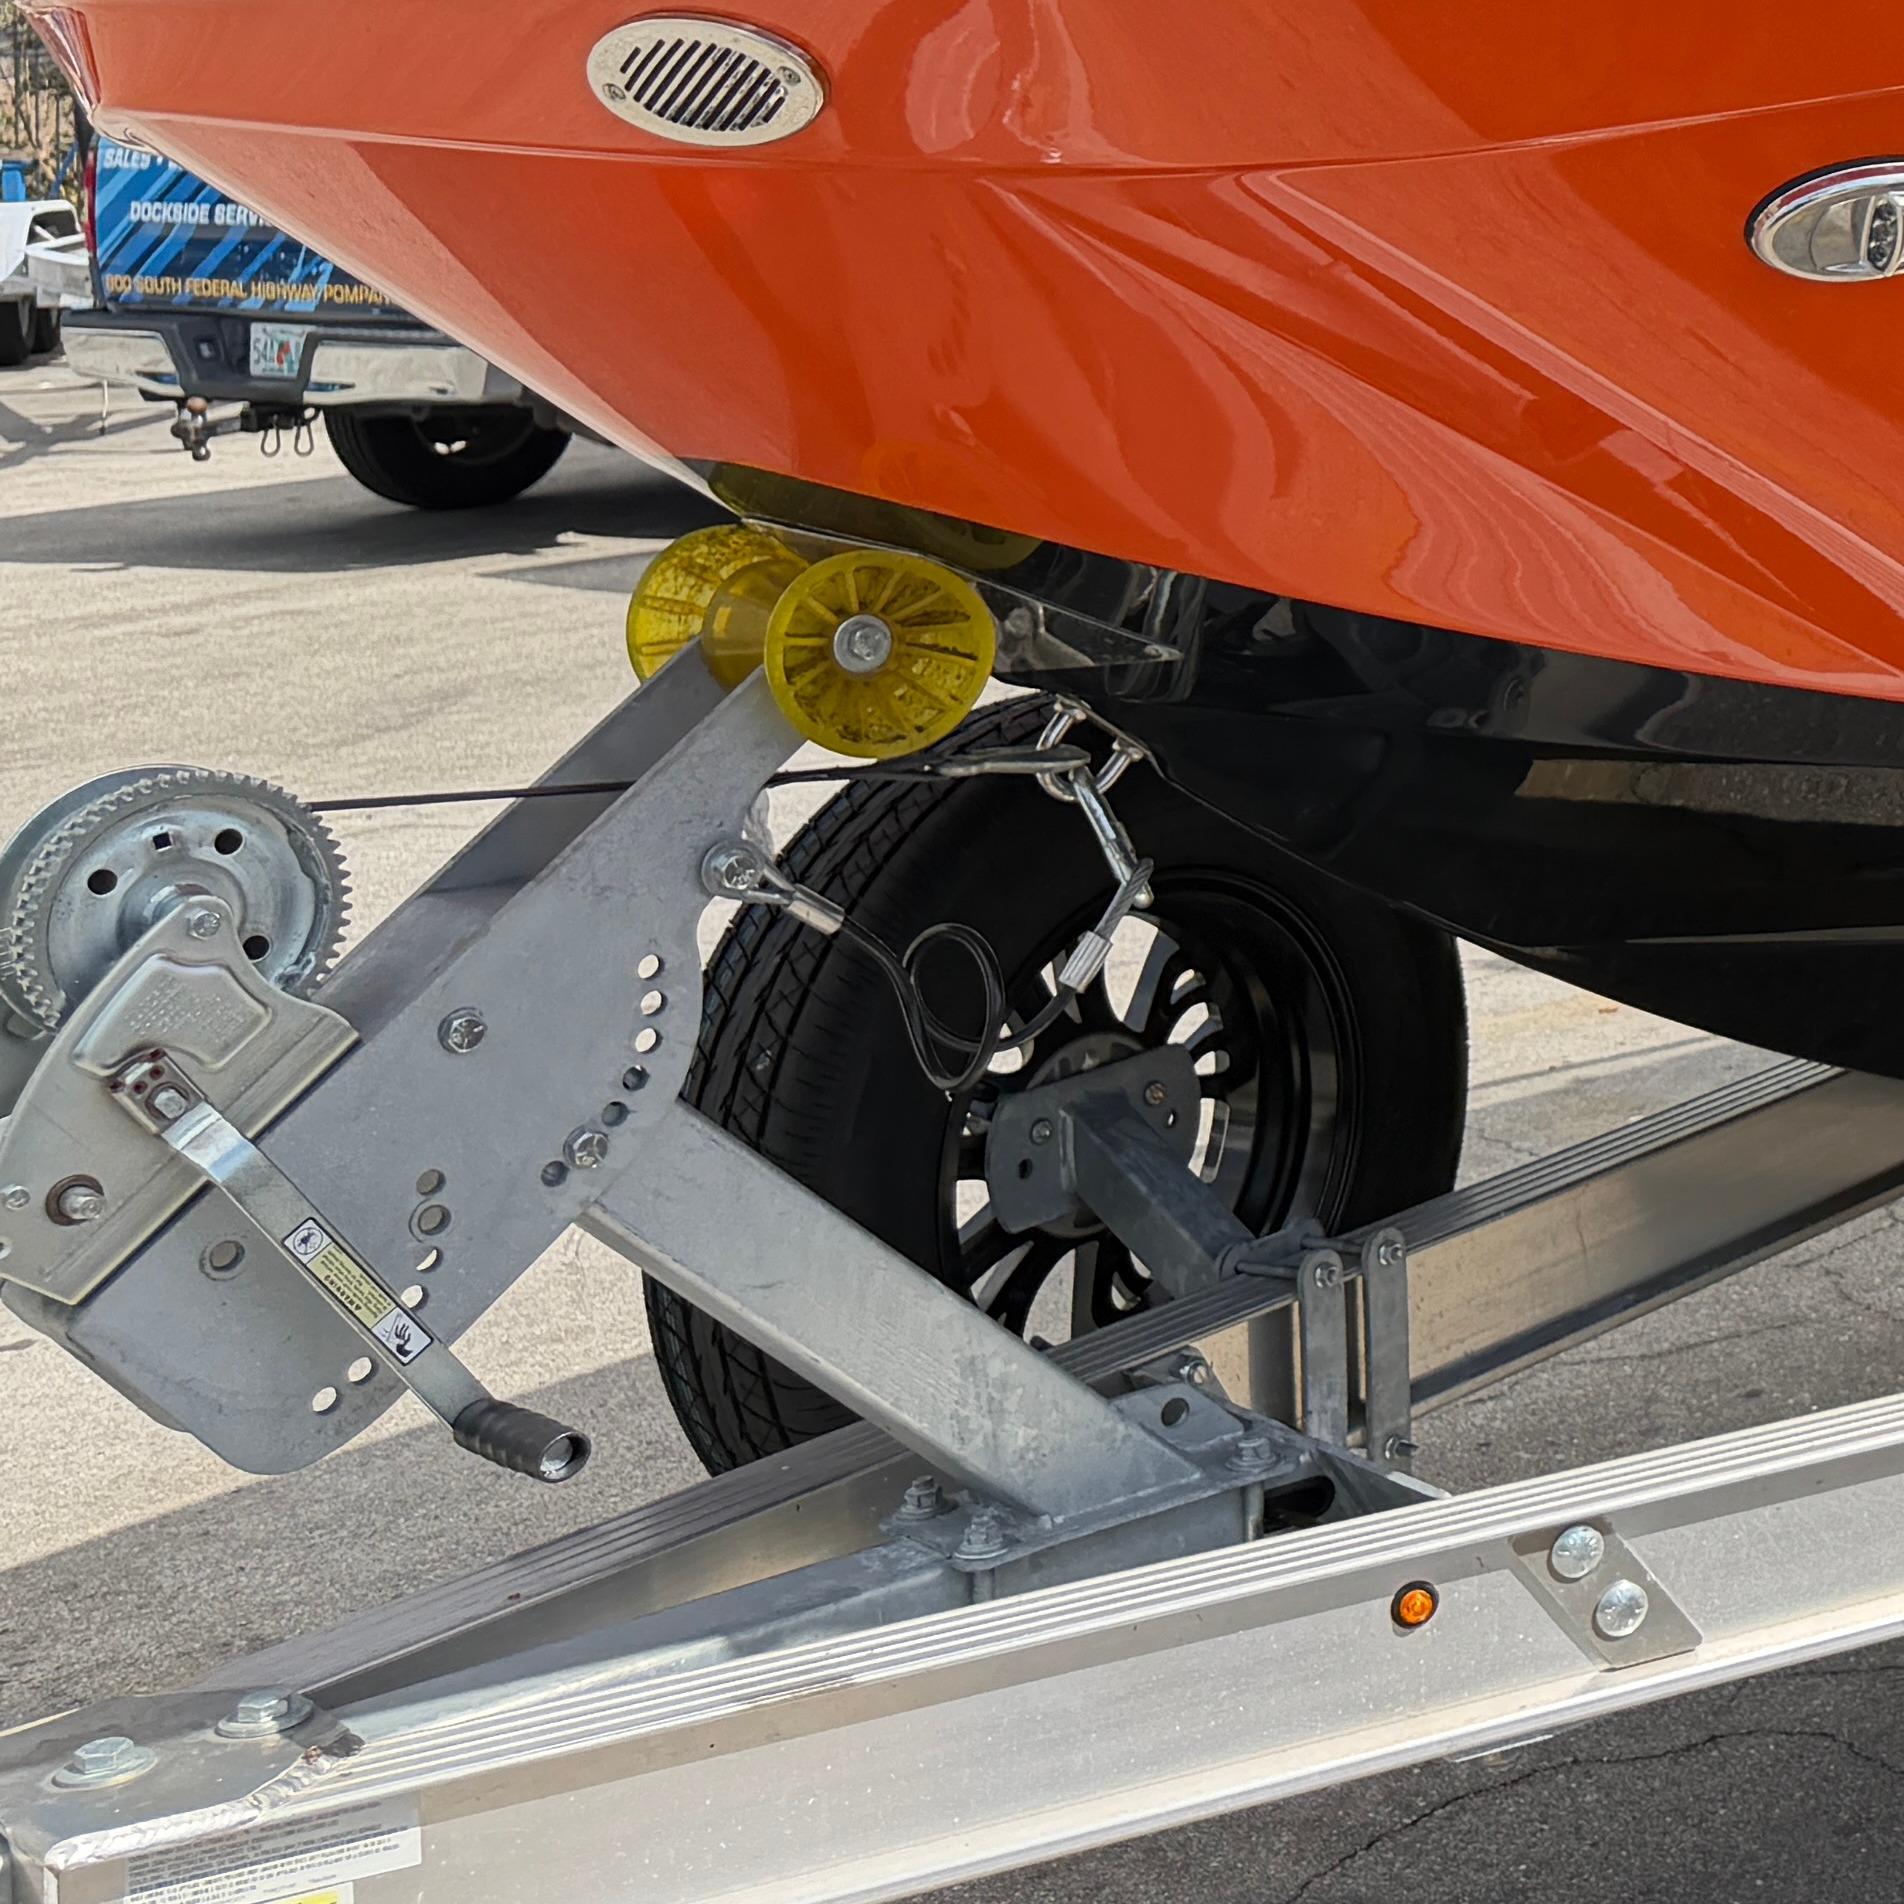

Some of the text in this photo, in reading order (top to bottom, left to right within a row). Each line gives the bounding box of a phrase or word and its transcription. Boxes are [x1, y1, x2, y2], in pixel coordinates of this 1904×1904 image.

[102, 147, 151, 170] SALES
[129, 200, 273, 228] DOCKSIDE SERV
[184, 277, 248, 297] FEDERAL
[251, 281, 318, 302] HIGHWAY
